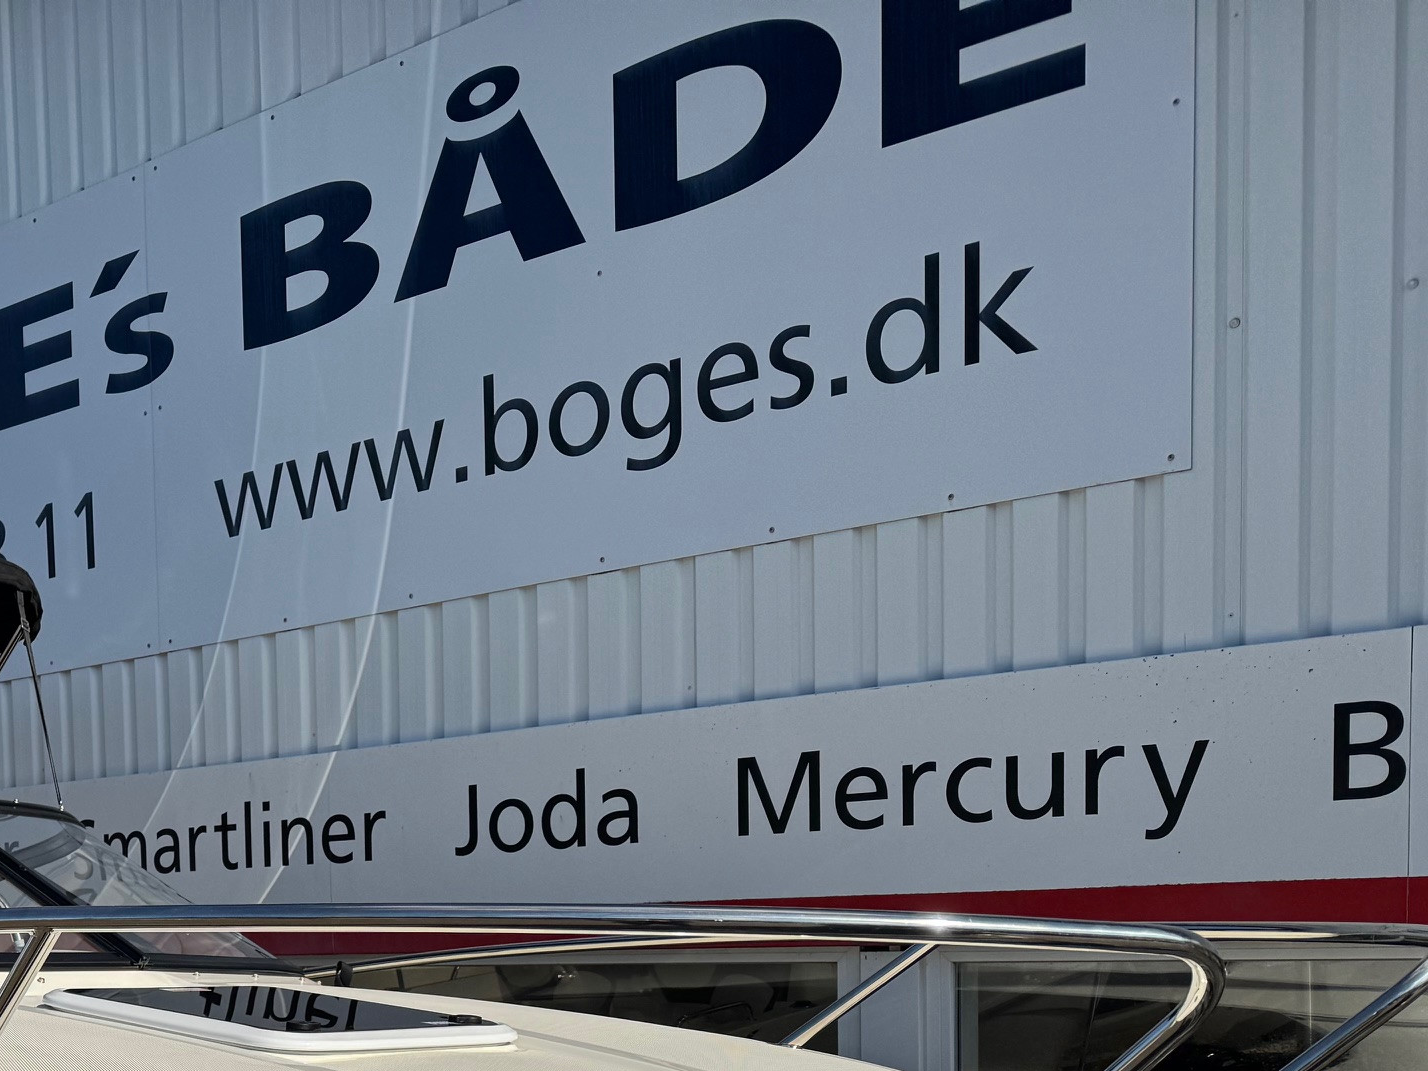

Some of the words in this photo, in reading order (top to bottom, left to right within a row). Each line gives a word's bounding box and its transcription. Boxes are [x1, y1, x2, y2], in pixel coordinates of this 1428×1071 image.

[240, 0, 1086, 351] BÅDE
[215, 241, 1038, 539] www.boges.dk
[35, 491, 95, 579] 11
[455, 768, 639, 856] Joda
[736, 739, 1210, 840] Mercury
